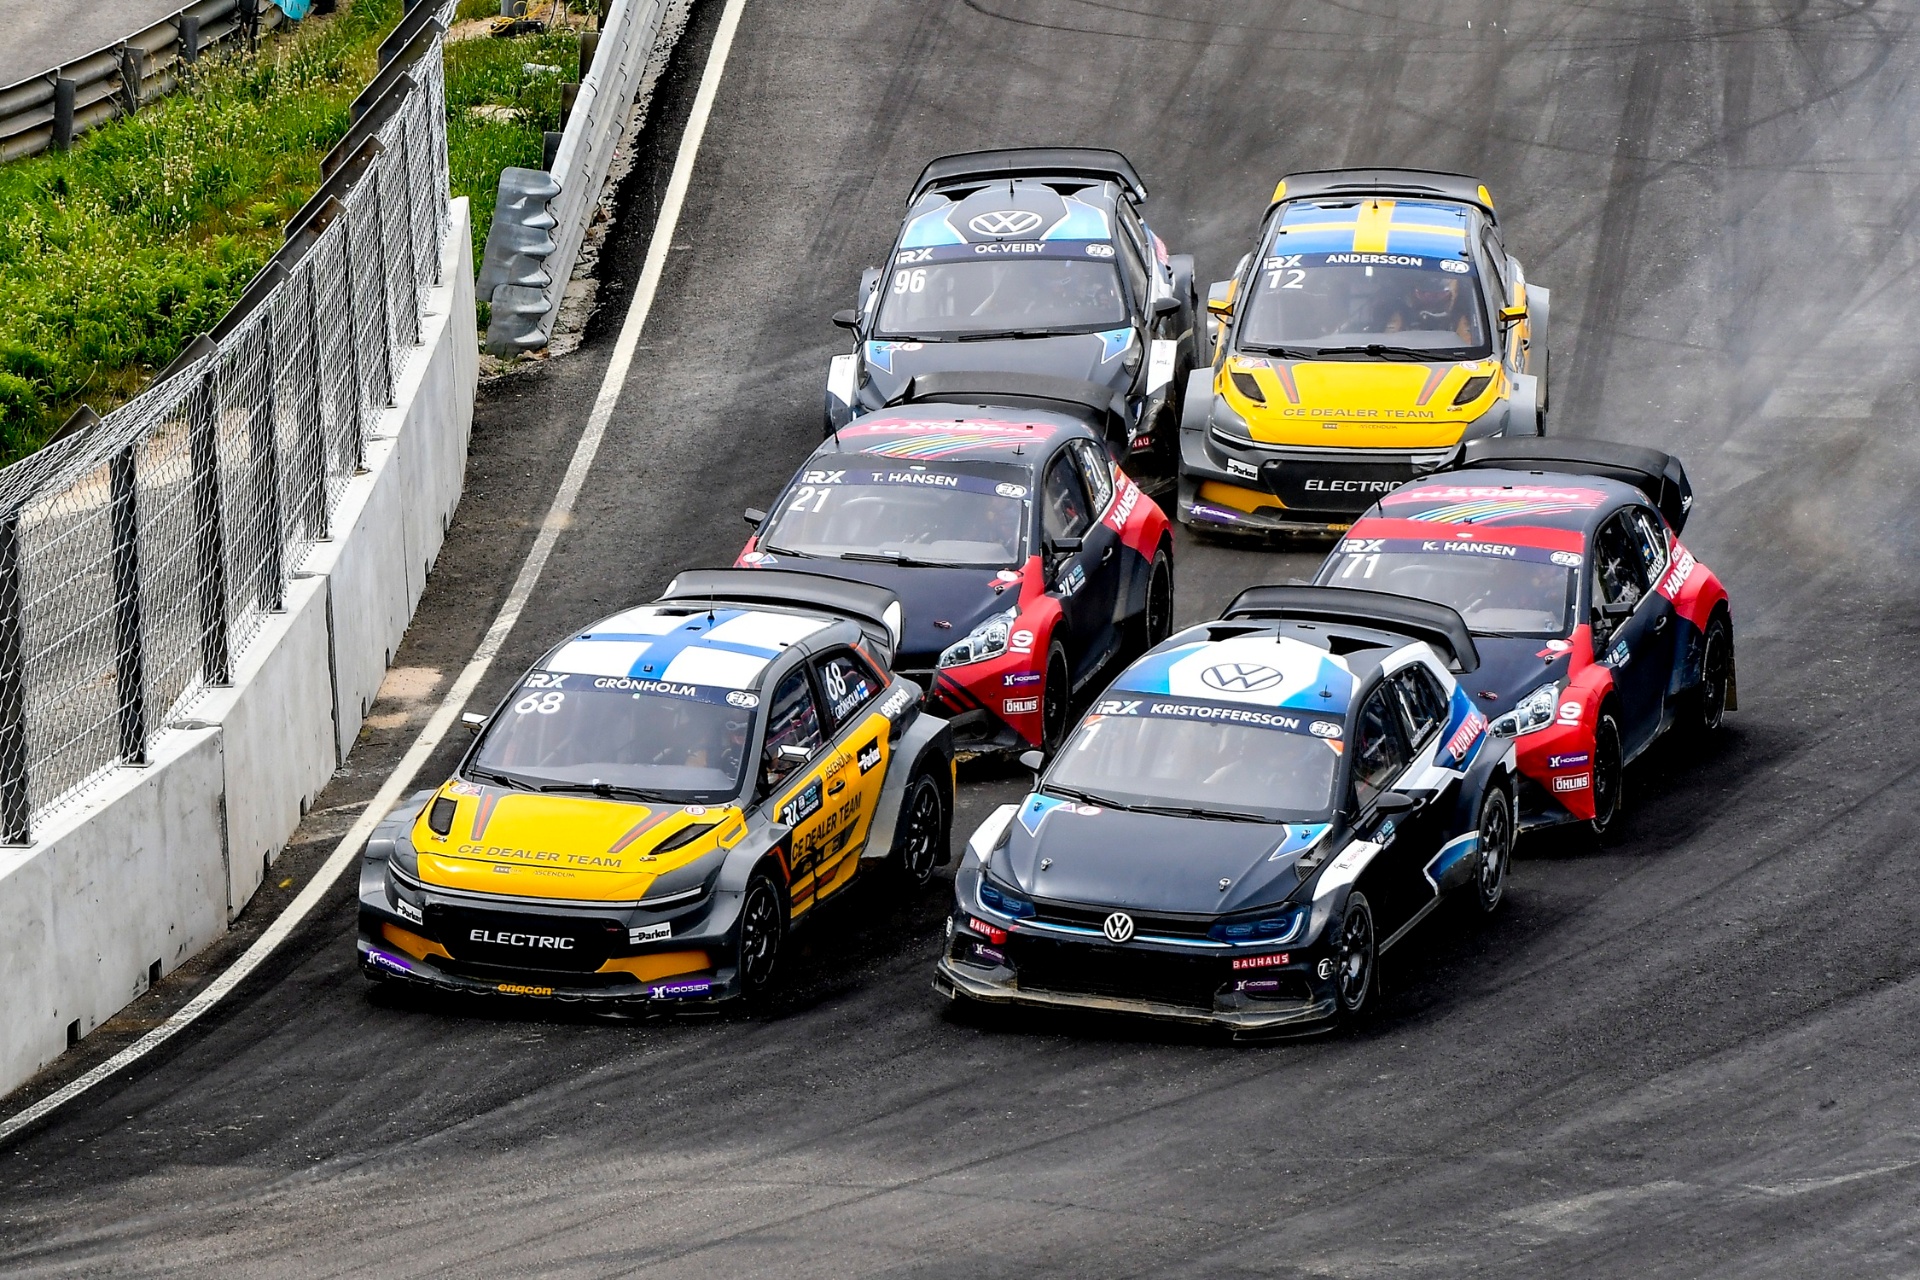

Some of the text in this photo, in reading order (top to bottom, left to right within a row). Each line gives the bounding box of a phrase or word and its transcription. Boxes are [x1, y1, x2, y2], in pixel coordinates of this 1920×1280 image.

[974, 243, 1046, 254] OC.VEIBY
[1325, 254, 1423, 267] ANDERSSON
[893, 268, 926, 294] 96
[1266, 269, 1306, 290] 12
[1283, 408, 1434, 418] CE DEALER TEAM
[871, 472, 958, 487] T. HANSEN
[1231, 464, 1257, 478] Parker
[1304, 479, 1403, 492] ELECTRIC
[788, 486, 833, 513] 21
[1110, 481, 1140, 530] HANSEN
[1421, 541, 1517, 557] K. HANSEN
[1341, 553, 1382, 579] 71
[1663, 549, 1697, 600] HANSEN
[593, 676, 697, 697] GRÖNHOLM
[824, 661, 847, 701] 68
[513, 691, 566, 715] 68
[880, 686, 911, 718] engcon
[1005, 699, 1037, 713] ÖHLINS
[1149, 703, 1301, 730] KRISTOFFERSSON
[1078, 723, 1101, 751] 1
[1555, 776, 1588, 790] ÖHLINS
[792, 837, 804, 862] CE
[805, 812, 838, 852] DEALER
[839, 791, 862, 825] TEAM
[457, 844, 622, 868] CE DEALER TEAM
[400, 905, 422, 924] Parker
[469, 928, 576, 950] ELECTRIC
[637, 927, 671, 942] Parker
[1232, 952, 1289, 969] BAUHAUS
[497, 982, 555, 996] engcon
[665, 982, 709, 995] HOOSIER
